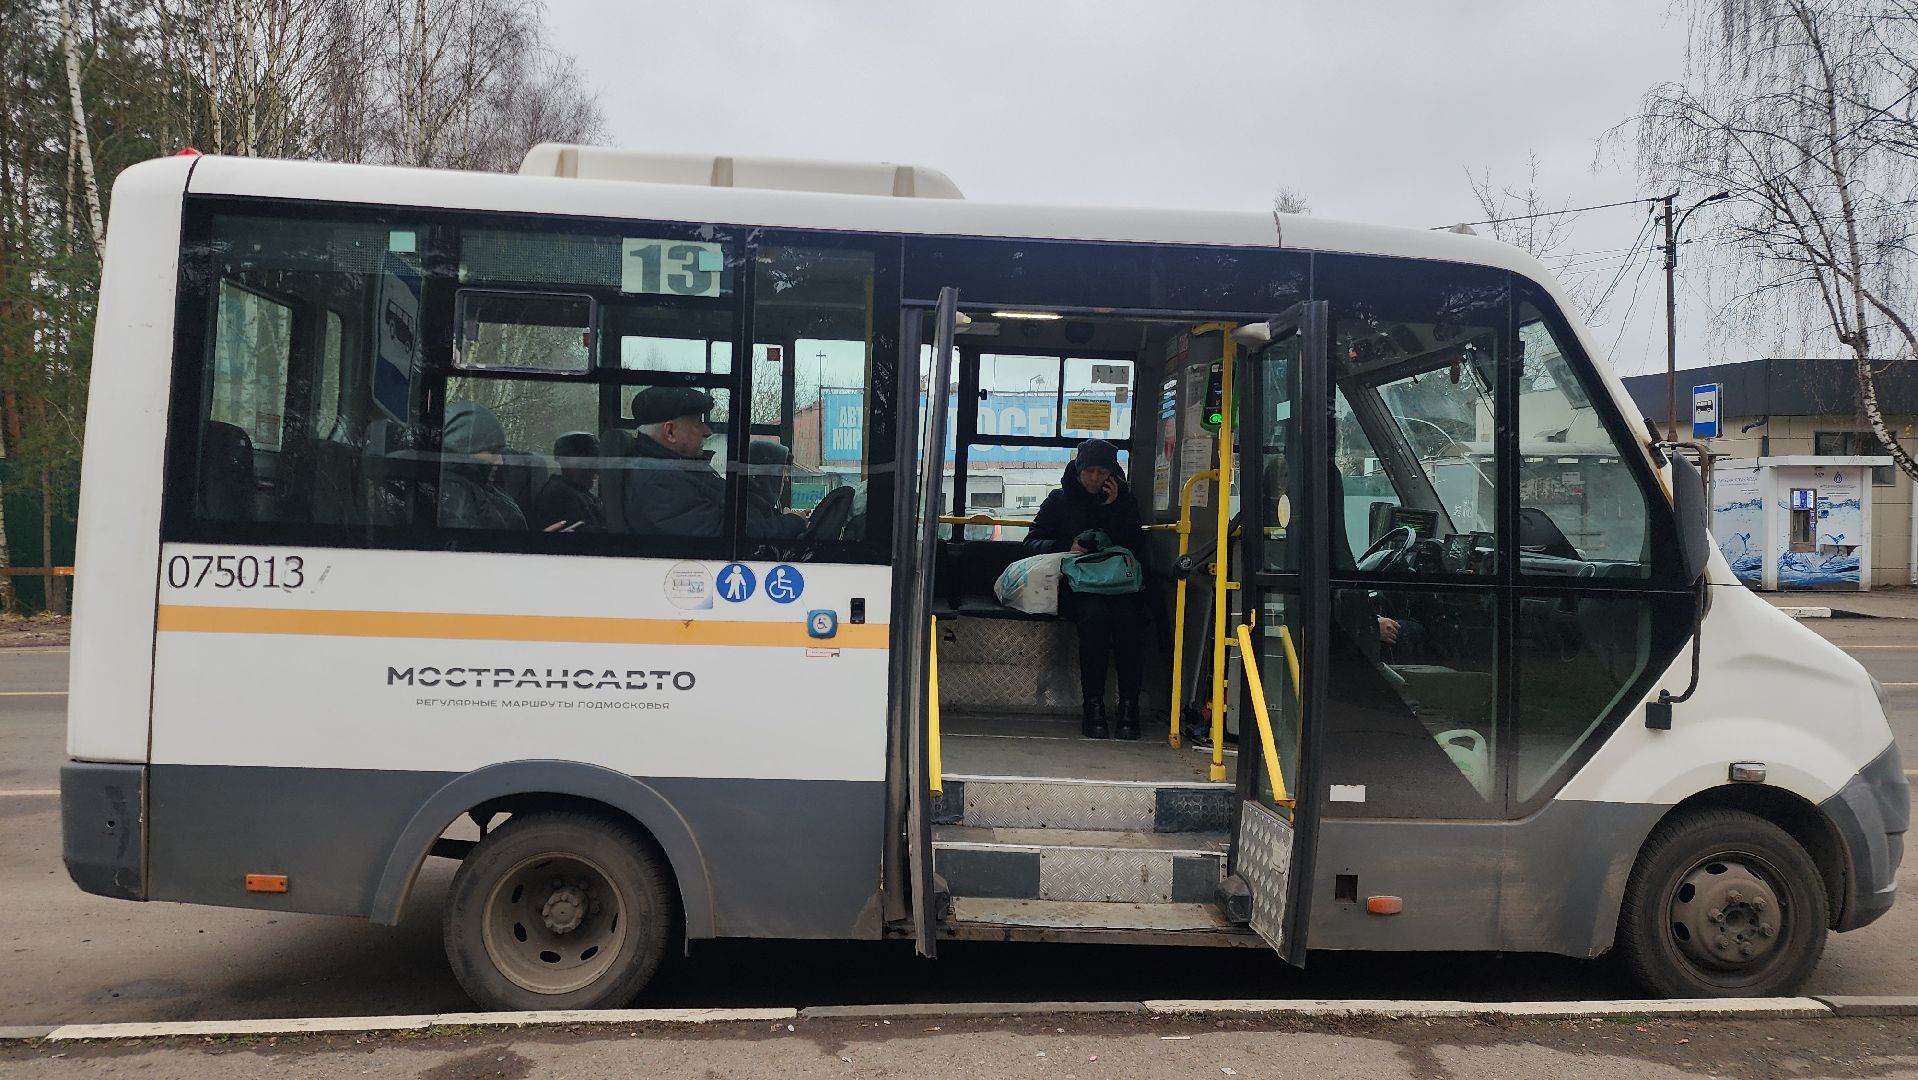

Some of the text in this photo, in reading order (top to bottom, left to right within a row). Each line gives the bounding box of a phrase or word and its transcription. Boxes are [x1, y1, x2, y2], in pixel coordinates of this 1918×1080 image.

[630, 244, 712, 295] 13
[168, 555, 304, 589] 075013
[387, 666, 696, 691] МОСТРАНСАВТО
[416, 698, 670, 710] РЕГУЛЯРНЫЕ МАРШРУТЫ ПОДМОСКОВЬЯ
